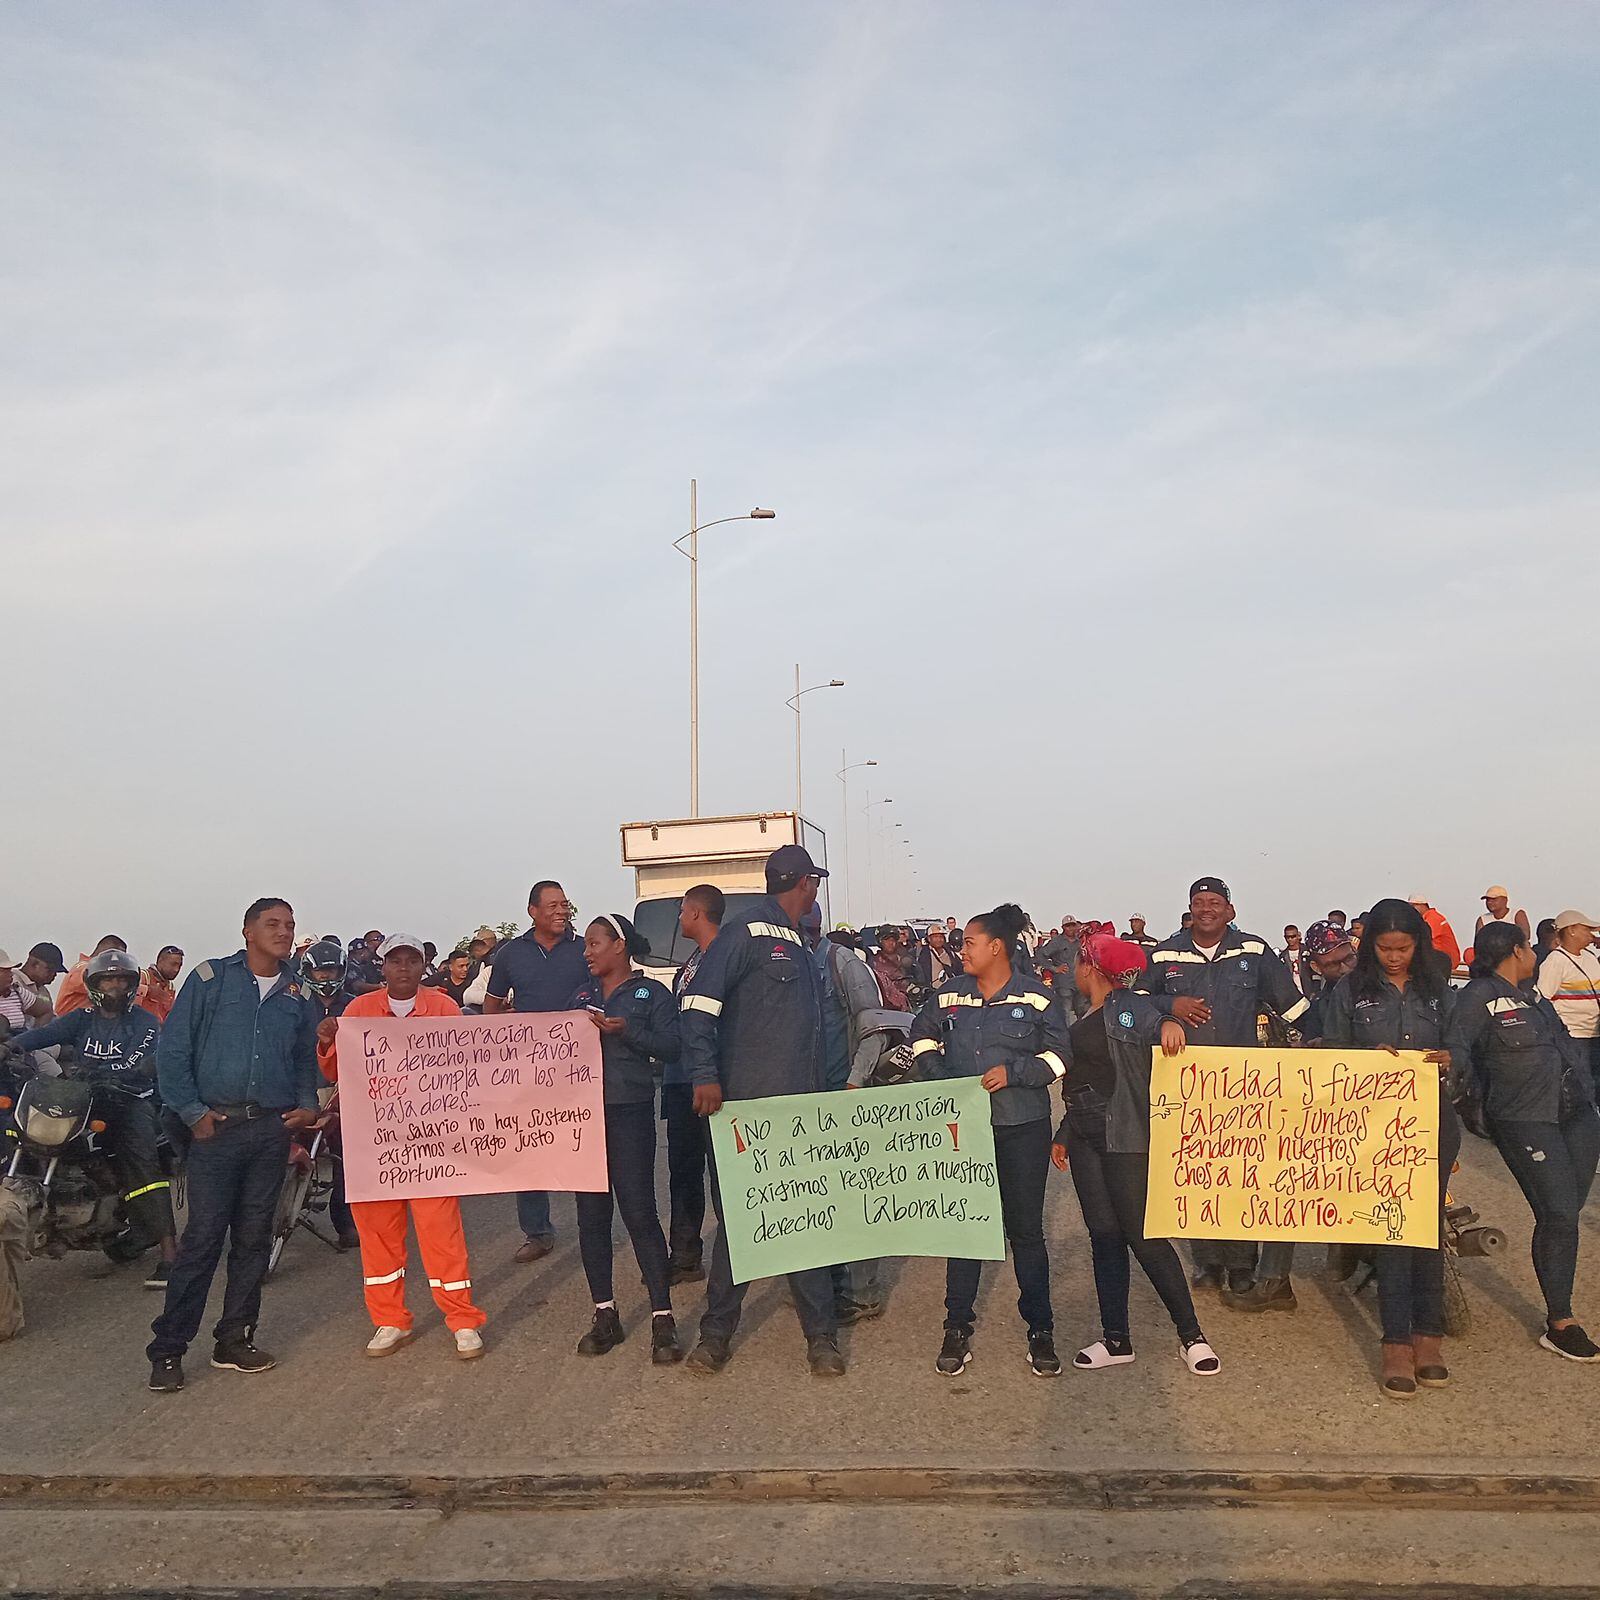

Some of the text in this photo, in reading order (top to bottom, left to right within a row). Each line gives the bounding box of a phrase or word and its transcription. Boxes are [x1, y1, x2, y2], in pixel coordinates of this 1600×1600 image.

[364, 1022, 574, 1057] La remuneración es
[366, 1040, 579, 1076] un derecho, no un favor.
[368, 1075, 408, 1100] SPEC
[491, 1067, 521, 1086] con
[534, 1066, 556, 1087] los
[564, 1064, 600, 1085] tra-
[1180, 1060, 1418, 1106] Unidad y fuerza
[469, 1116, 485, 1132] no
[495, 1112, 520, 1135] hay
[792, 1116, 806, 1137] a
[818, 1107, 838, 1132] la
[1294, 1106, 1371, 1141] juntos
[1385, 1106, 1430, 1141] de-
[452, 1136, 468, 1154] el
[515, 1129, 554, 1153] justo
[572, 1128, 582, 1152] y
[778, 1146, 796, 1167] al
[804, 1137, 870, 1162] trabajo
[1172, 1128, 1438, 1169] fendemos nuestros dere-
[840, 1163, 907, 1190] respeto
[917, 1163, 930, 1183] a
[933, 1156, 995, 1188] nuestros
[1241, 1158, 1260, 1190] la
[1269, 1163, 1414, 1200] estabilidad
[753, 1205, 836, 1244] derechos
[1174, 1195, 1188, 1229] y
[1200, 1194, 1221, 1228] al
